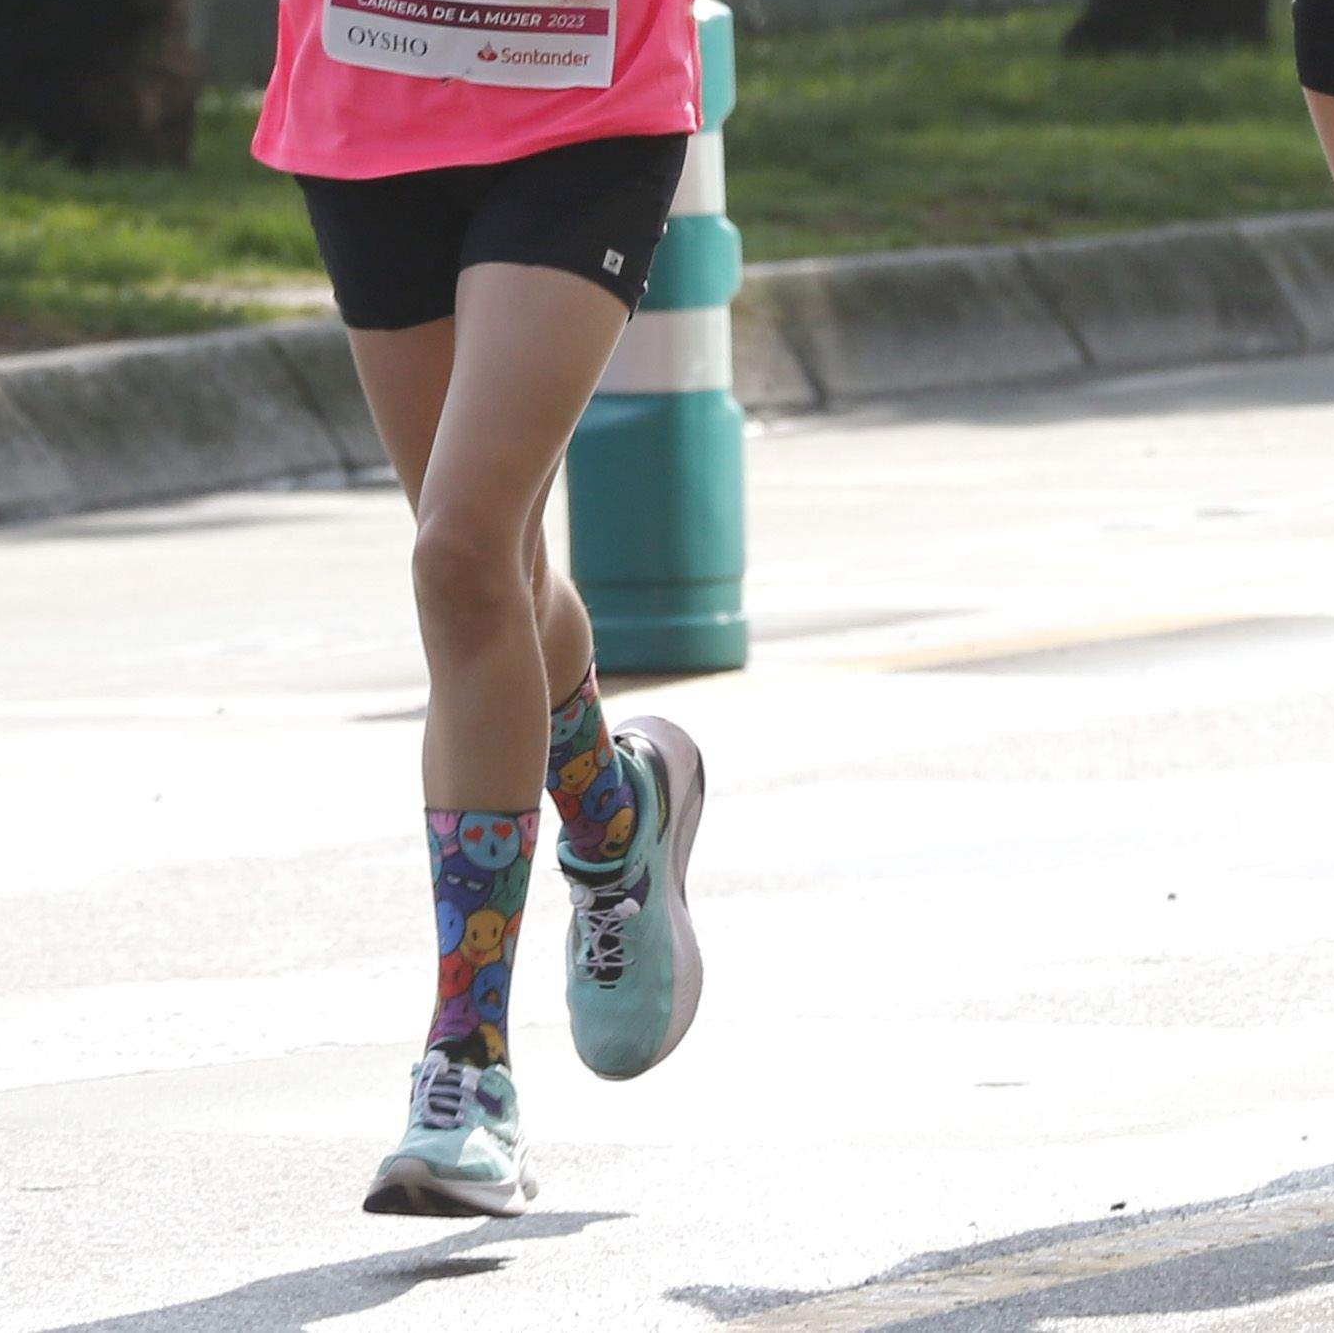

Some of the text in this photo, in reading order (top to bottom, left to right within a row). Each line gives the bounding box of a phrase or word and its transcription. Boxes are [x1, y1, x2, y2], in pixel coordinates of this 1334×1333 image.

[432, 6, 455, 21] DE
[459, 9, 480, 24] LA
[483, 10, 542, 27] MUJER
[547, 13, 586, 28] 2023
[347, 24, 592, 67] OYSHO Santander
